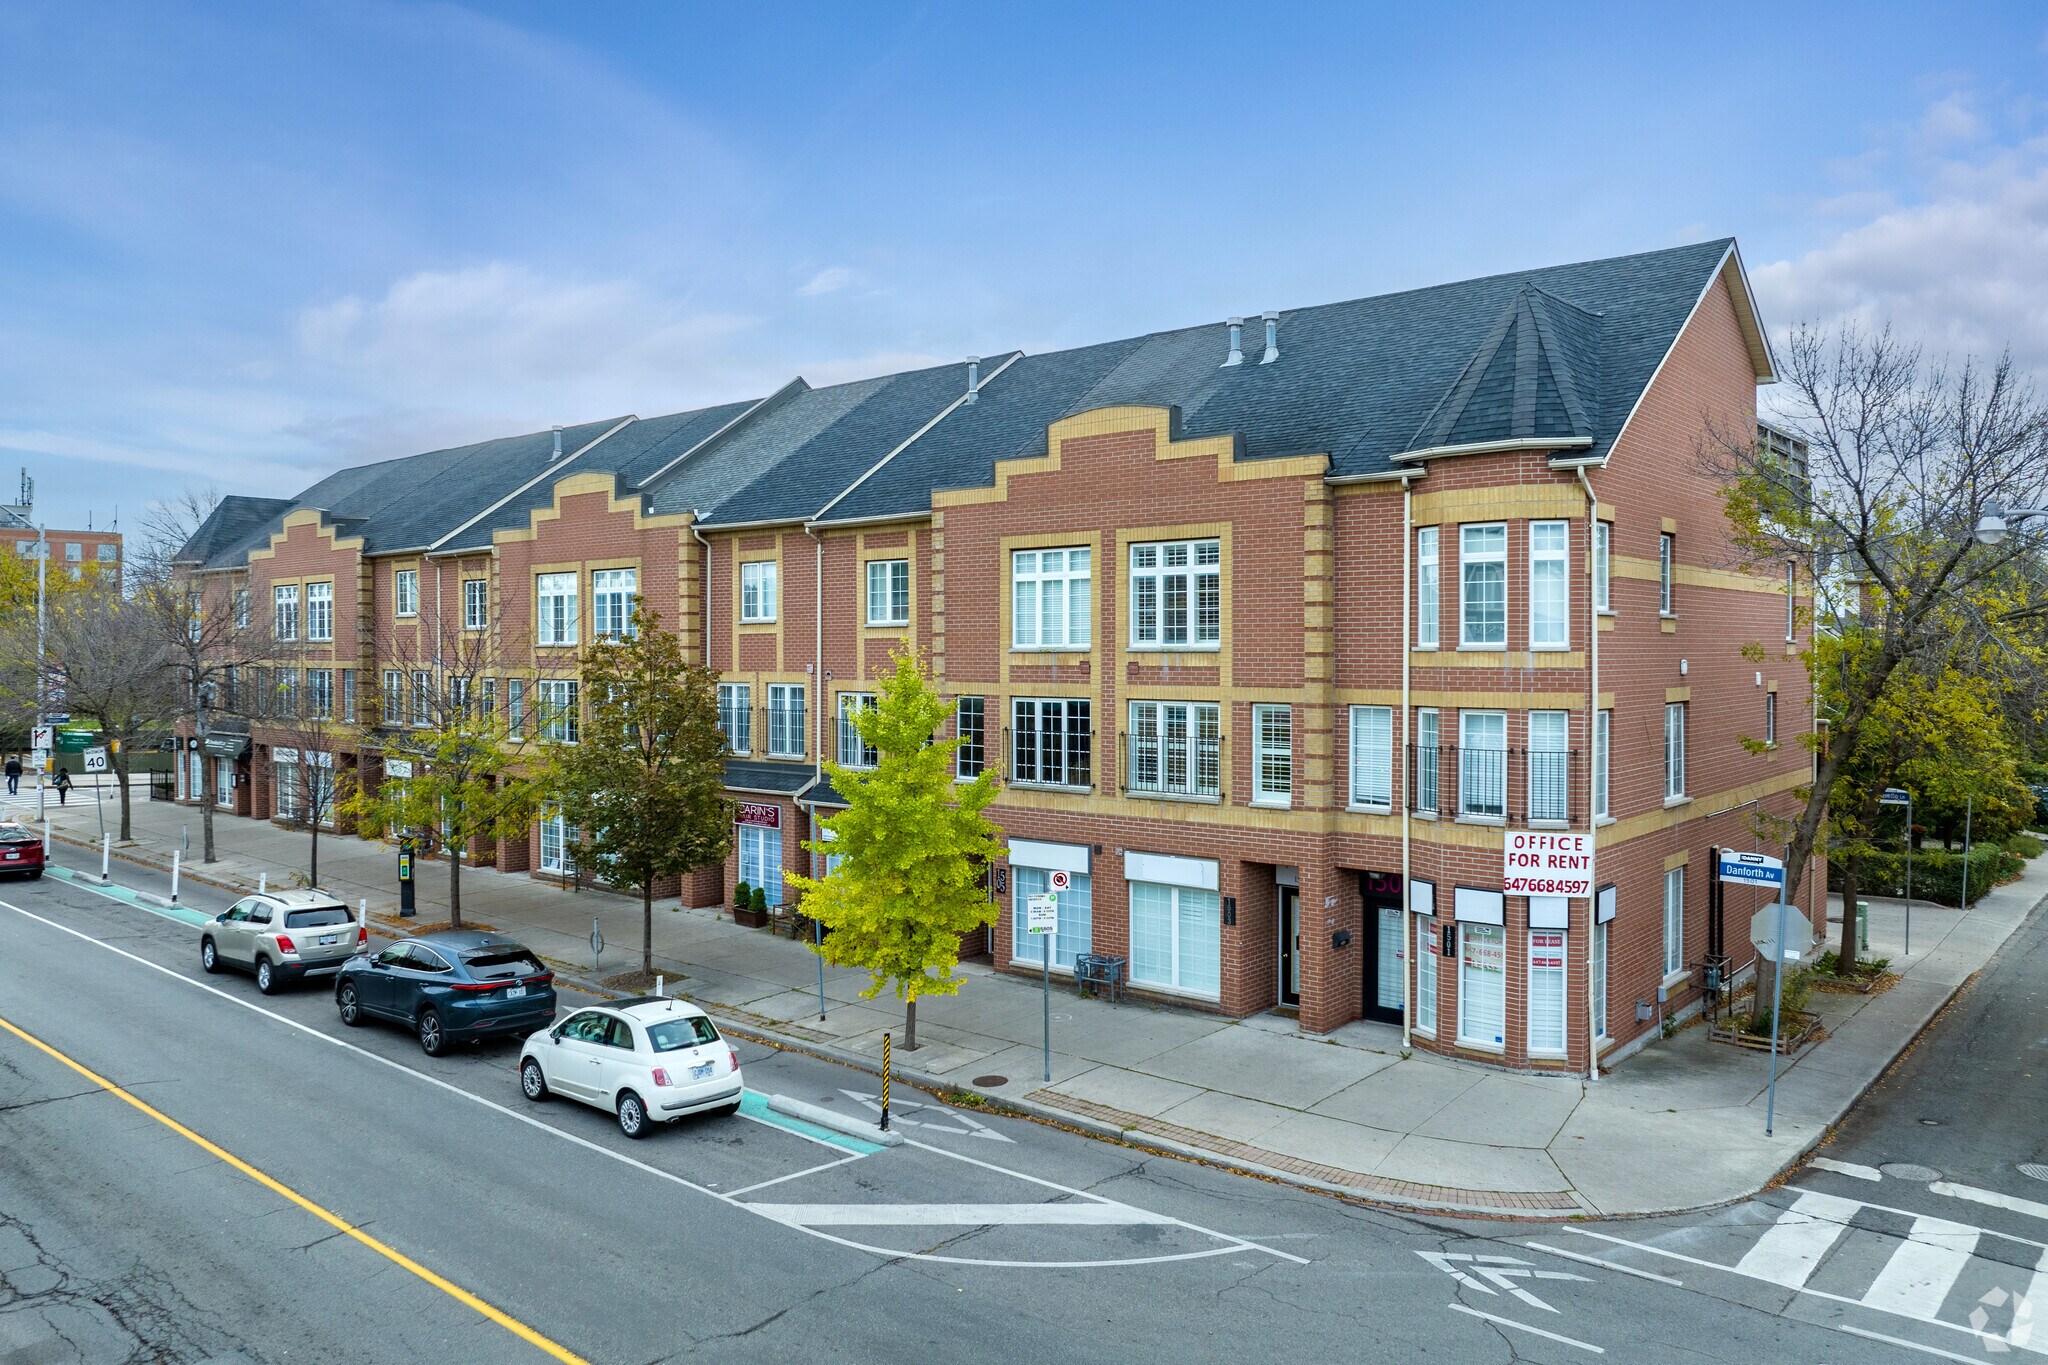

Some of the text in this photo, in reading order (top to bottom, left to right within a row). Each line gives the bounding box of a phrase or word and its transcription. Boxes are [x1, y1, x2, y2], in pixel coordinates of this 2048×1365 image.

[87, 756, 105, 768] 40
[754, 815, 775, 823] STUDIO
[1514, 835, 1583, 851] OFFICE
[1508, 852, 1590, 870] FOR RENT
[1726, 864, 1775, 879] Danforth Av
[1504, 877, 1589, 894] 6476684597
